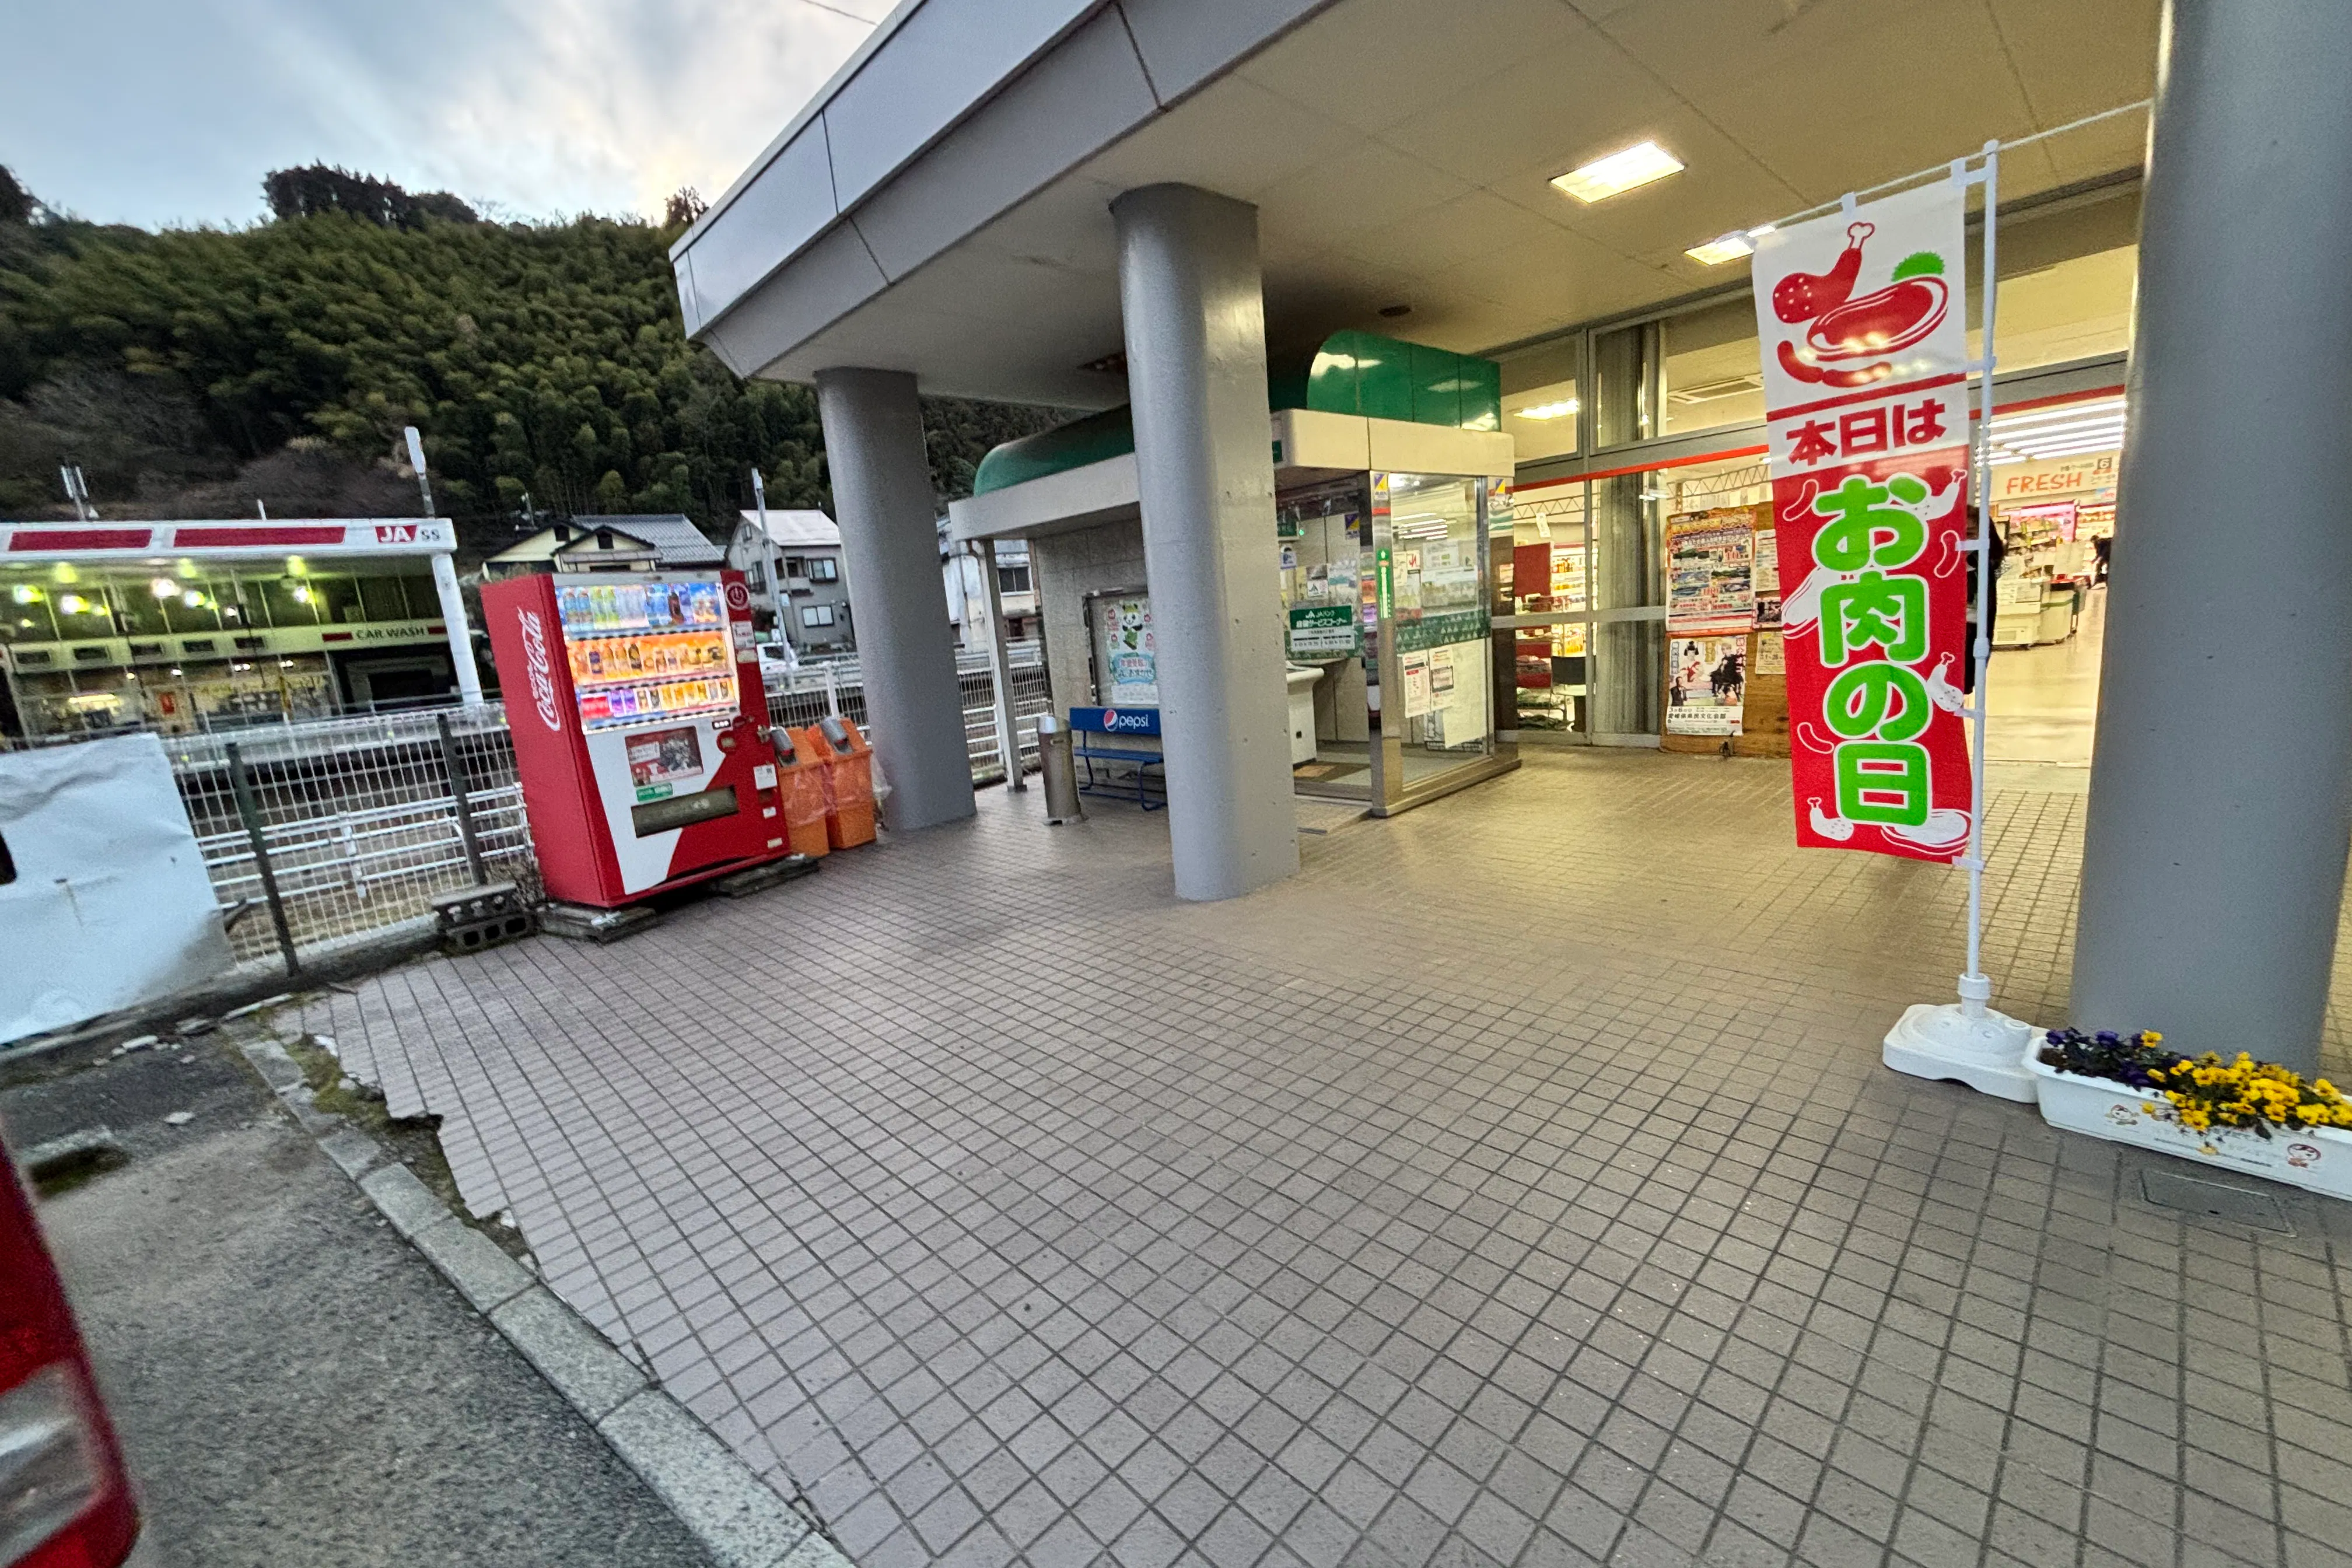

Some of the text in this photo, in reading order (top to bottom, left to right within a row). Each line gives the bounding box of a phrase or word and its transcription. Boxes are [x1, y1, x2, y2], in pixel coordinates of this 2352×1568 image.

[1786, 398, 1947, 466] 本日は
[2006, 471, 2082, 495] FRESH
[381, 526, 441, 542] JA SS
[356, 626, 425, 640] CAR WASH
[1812, 473, 1933, 828] お肉の日
[1119, 714, 1150, 730] pepsi
